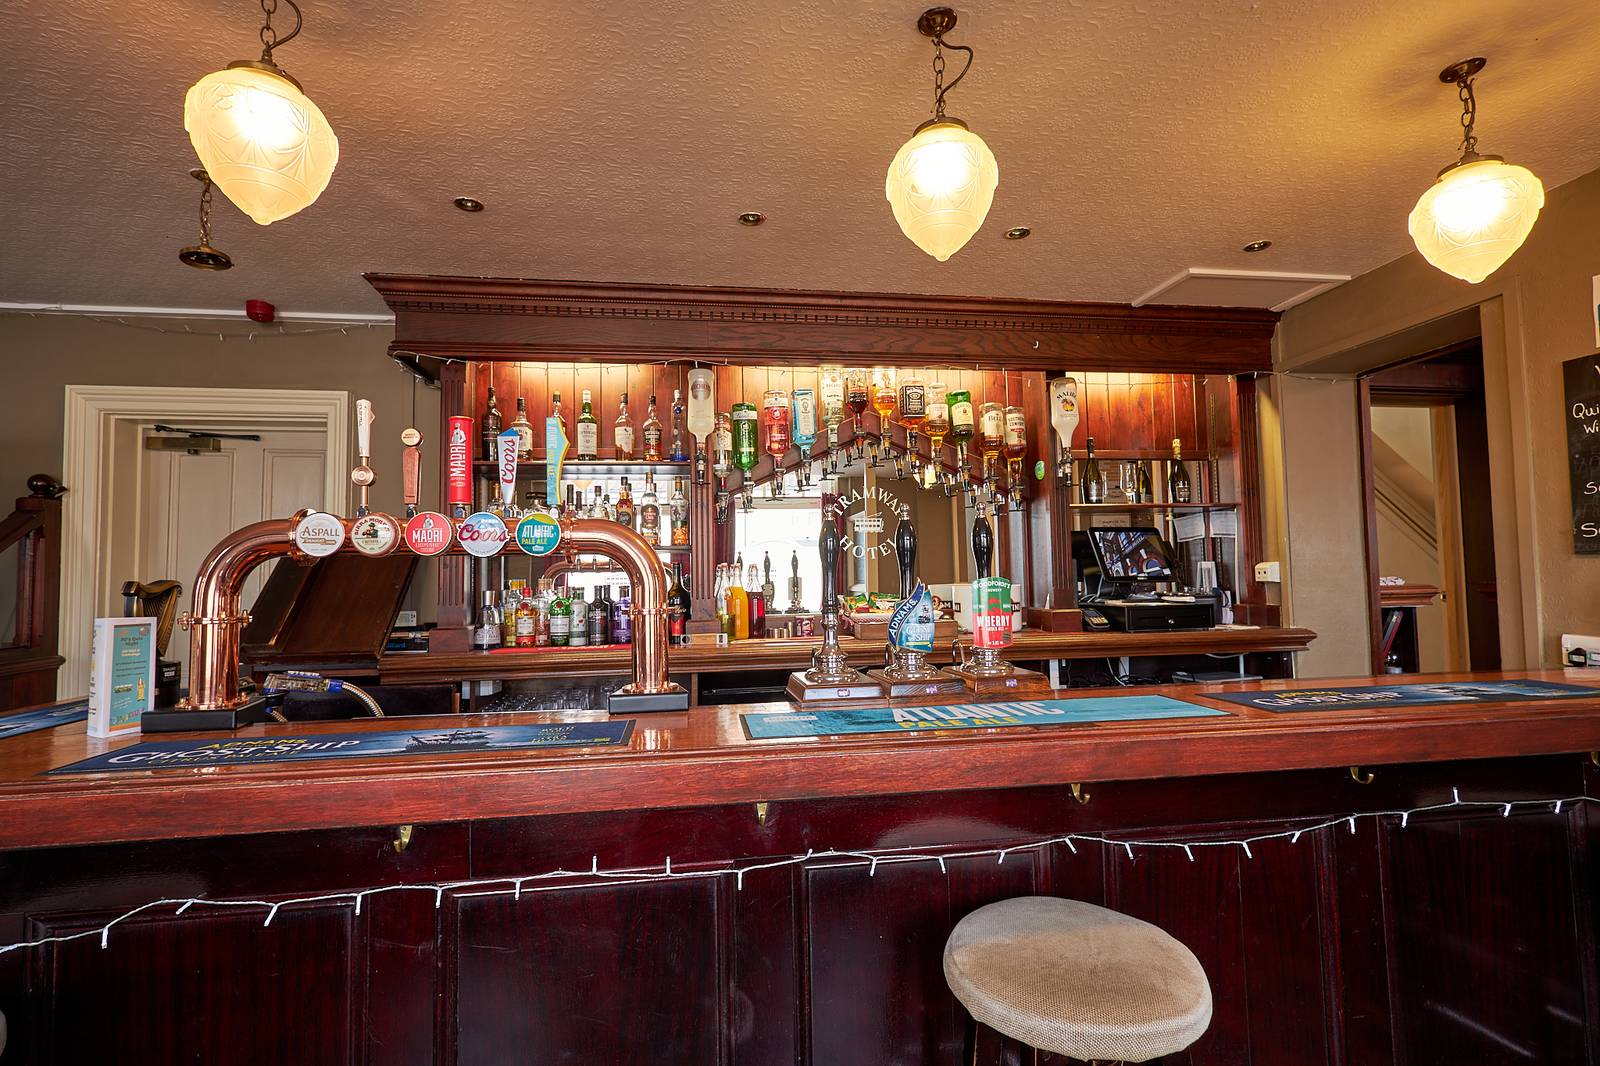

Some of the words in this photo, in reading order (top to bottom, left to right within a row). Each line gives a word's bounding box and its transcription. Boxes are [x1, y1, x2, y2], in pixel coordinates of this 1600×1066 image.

[501, 438, 516, 484] Coors
[1583, 481, 1600, 495] S
[300, 526, 340, 538] ASPALL
[458, 523, 510, 542] Coors
[521, 525, 555, 538] ATLANTIC
[1581, 522, 1600, 538] S
[976, 615, 1010, 627] WHERRY
[892, 702, 1065, 722] ATLANTIC
[898, 719, 967, 729] PALE
[970, 716, 1024, 725] ALE
[196, 739, 308, 750] ADNAMS
[108, 746, 269, 764] GHOST
[266, 740, 361, 753] SHIP
